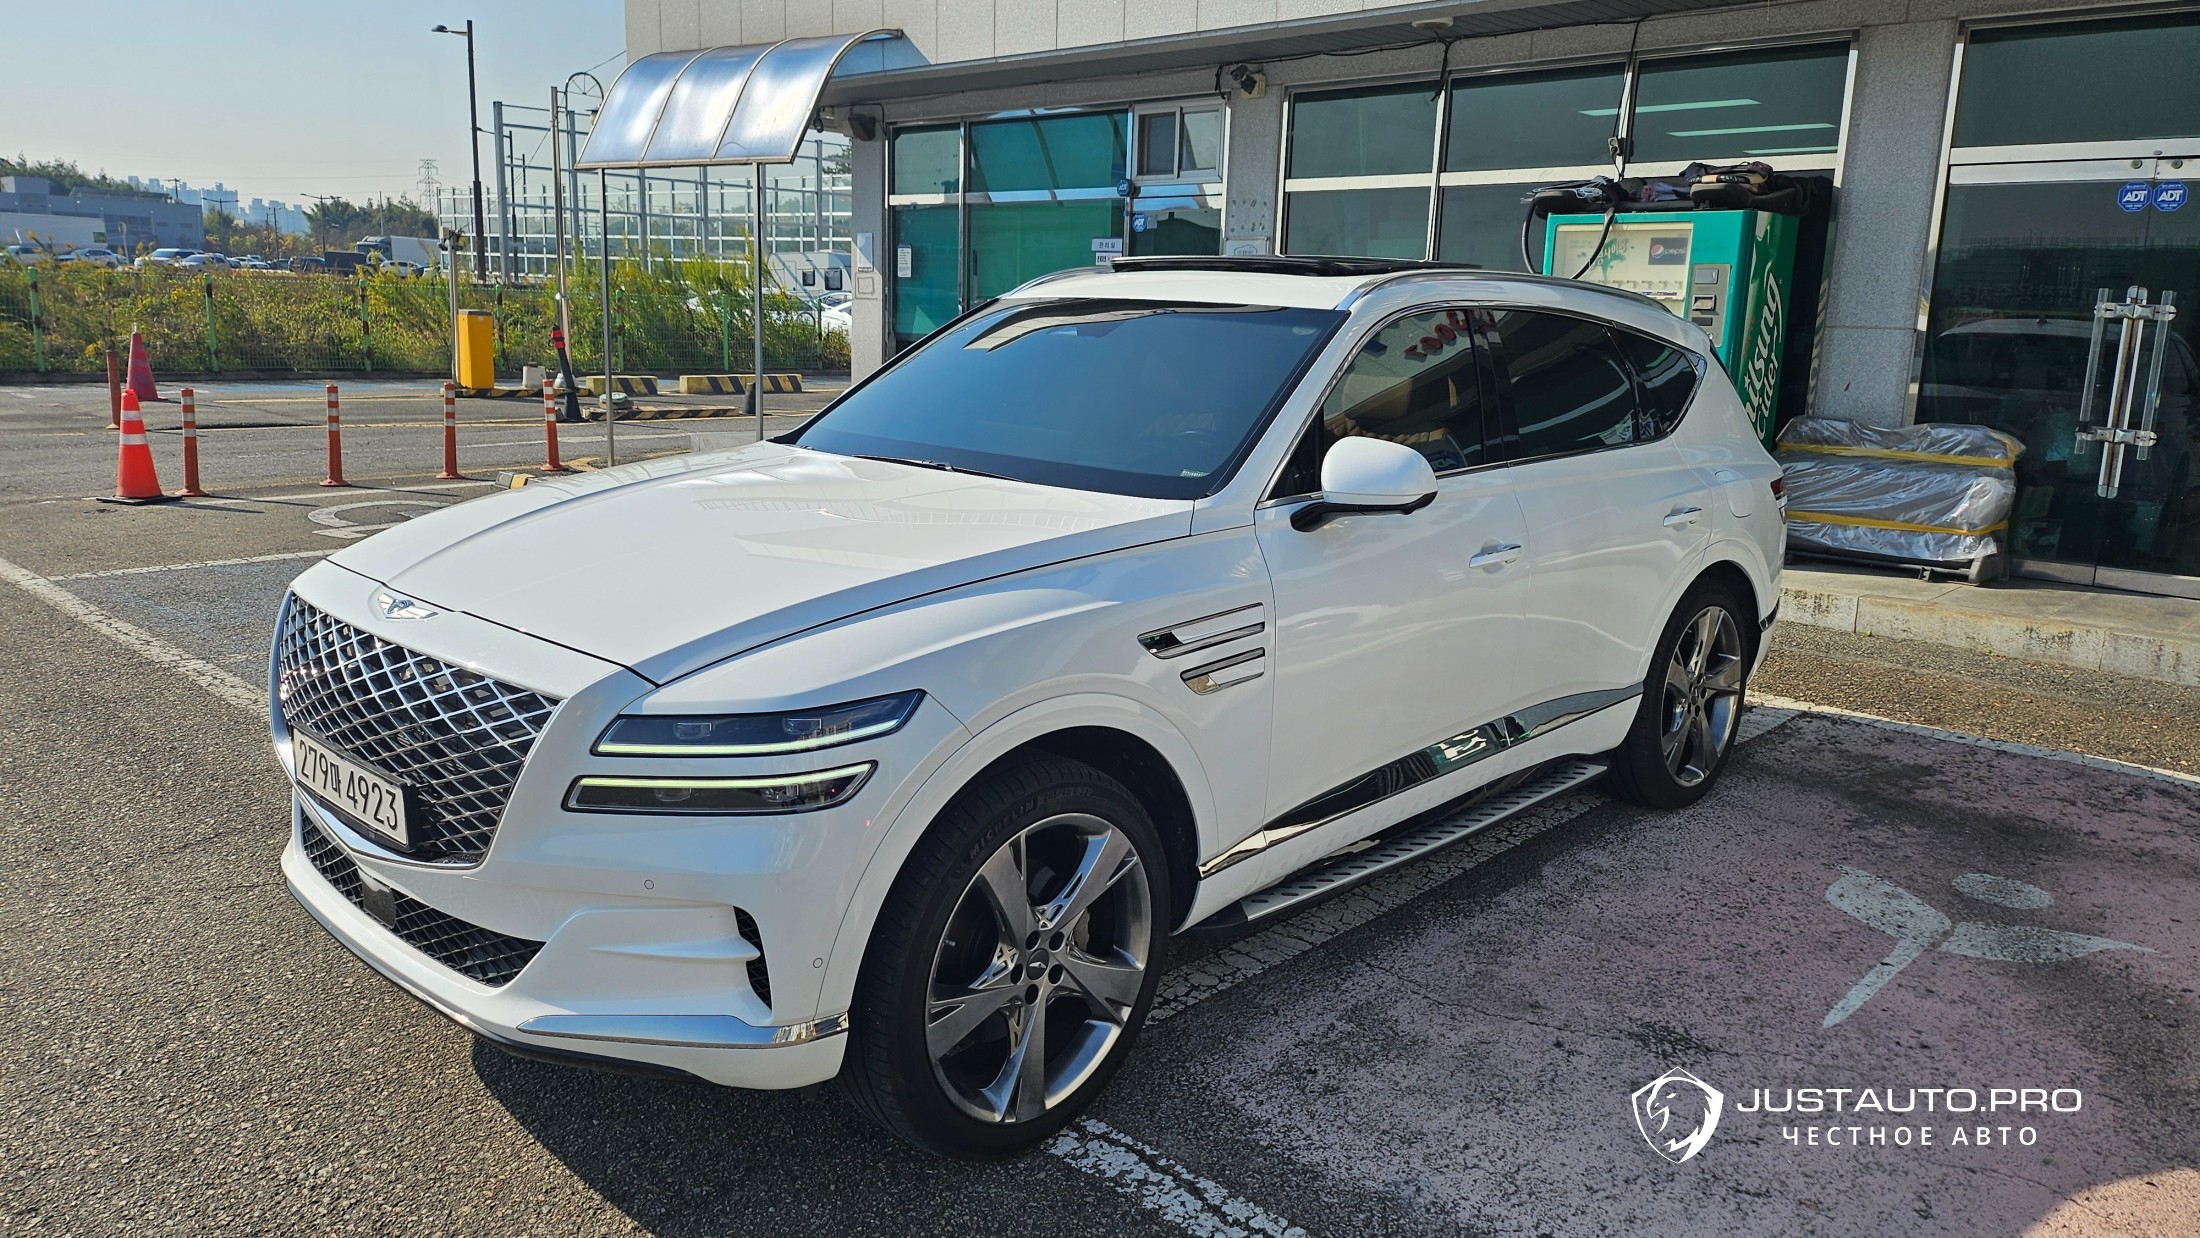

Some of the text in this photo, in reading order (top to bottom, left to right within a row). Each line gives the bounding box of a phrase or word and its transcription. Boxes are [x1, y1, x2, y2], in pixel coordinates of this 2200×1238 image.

[2122, 190, 2148, 202] ADT
[2157, 190, 2184, 202] ADT
[1664, 247, 1686, 256] pepsi
[1757, 325, 1779, 441] Cider
[299, 739, 398, 831] 279마 4923
[969, 800, 1034, 860] MICHELIN
